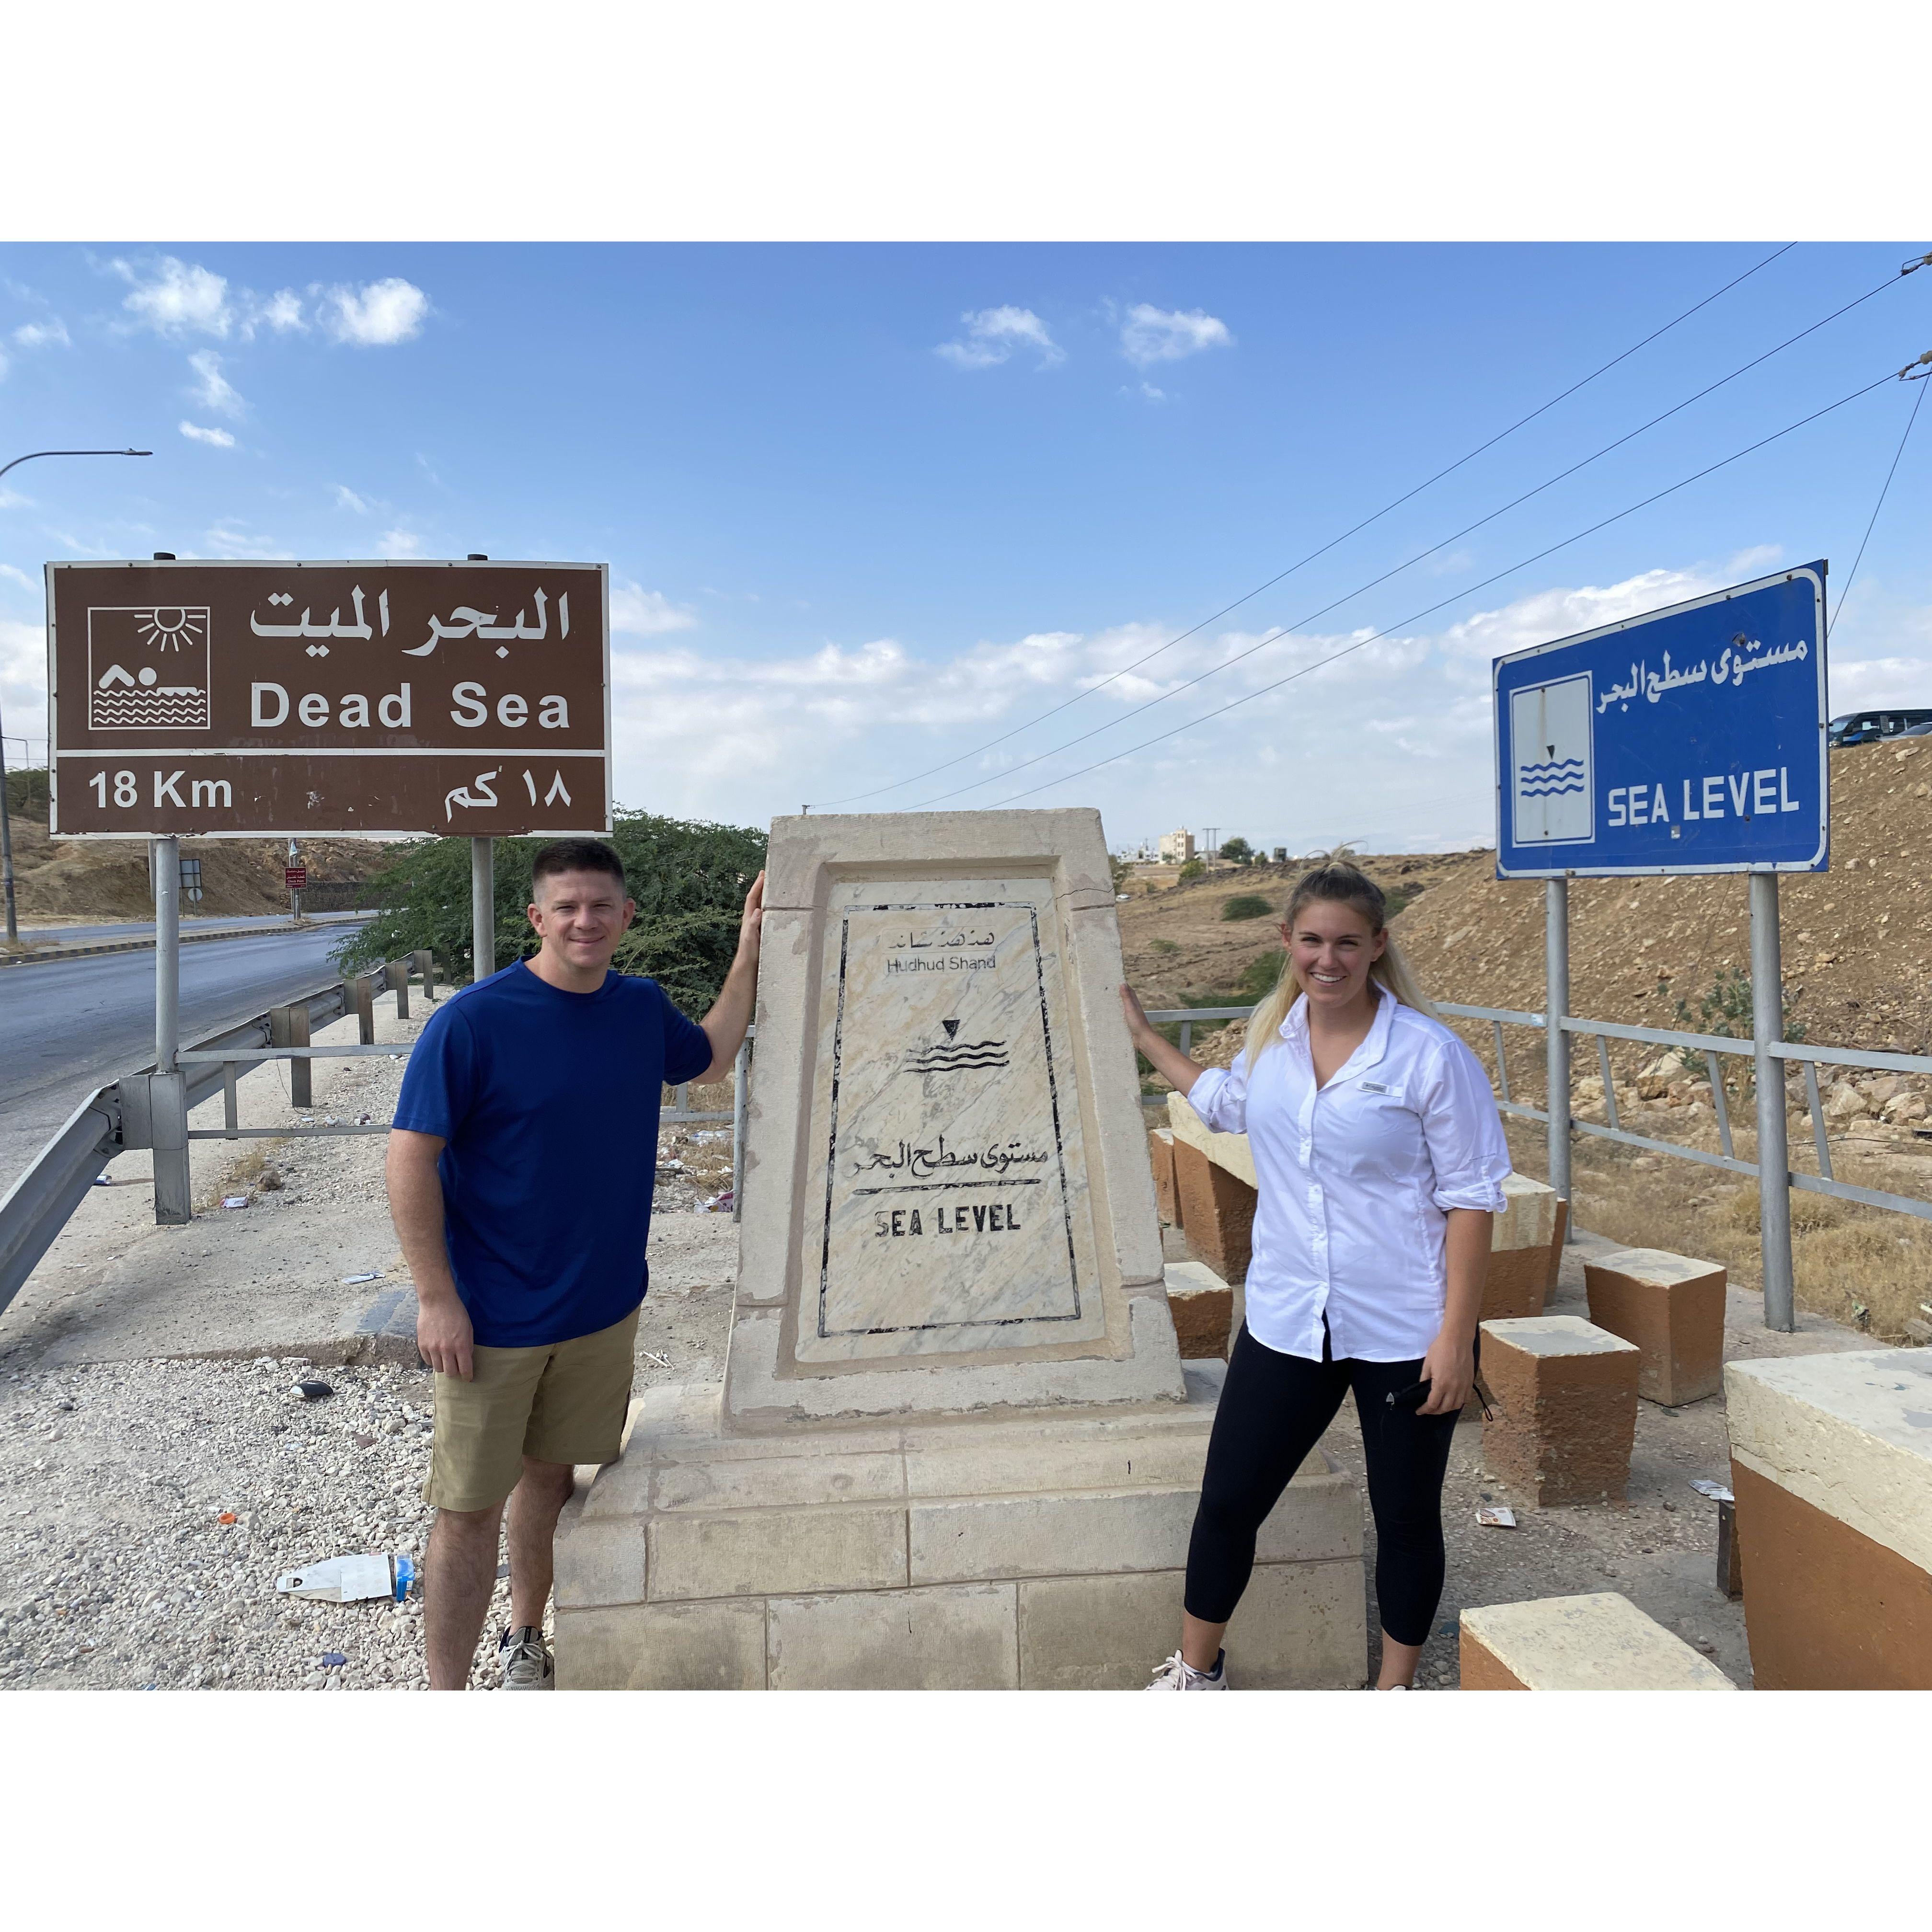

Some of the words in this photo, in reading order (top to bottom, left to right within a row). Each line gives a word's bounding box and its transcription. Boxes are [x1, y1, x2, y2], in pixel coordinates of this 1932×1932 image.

[250, 585, 390, 657] الميت
[402, 586, 569, 658] البحر
[1647, 650, 1708, 703] سطح
[1711, 640, 1808, 686] مستوى
[251, 682, 411, 728] Dead
[450, 681, 570, 729] Sea
[1596, 659, 1645, 714] البحر
[89, 770, 138, 808] 18
[154, 770, 232, 808] Km
[445, 770, 498, 823] كم
[522, 769, 572, 807] ١٨
[1608, 783, 1670, 827] SEA
[1683, 767, 1800, 821] LEVEL
[887, 956, 944, 973] Hudhud
[949, 955, 996, 971] Shand
[844, 1139, 910, 1179] البحر
[911, 1134, 978, 1179] سطح
[980, 1142, 1048, 1173] مستوى
[874, 1209, 923, 1238] SEA
[938, 1204, 1021, 1234] LEVEL
